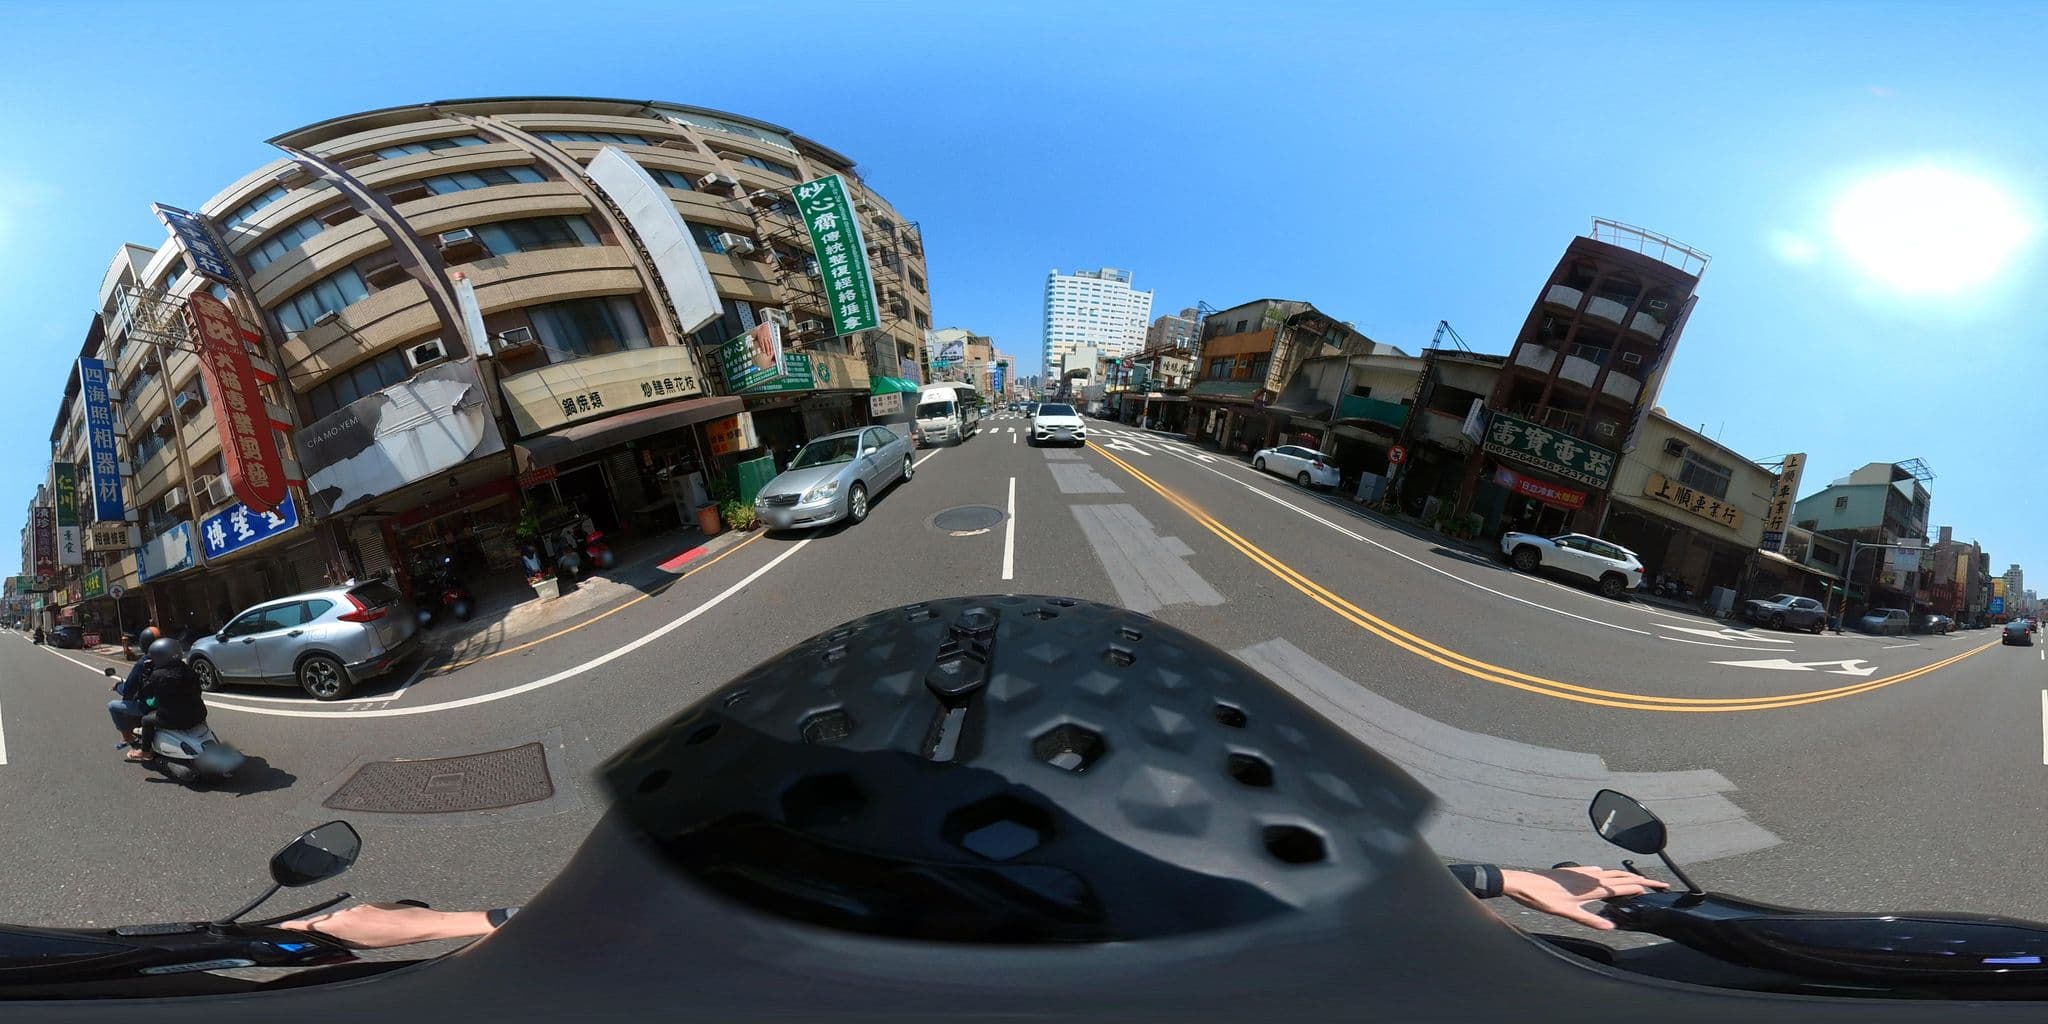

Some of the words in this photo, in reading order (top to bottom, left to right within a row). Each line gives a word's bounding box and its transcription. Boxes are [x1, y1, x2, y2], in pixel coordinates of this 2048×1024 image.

[820, 231, 863, 330] 傳統整復經絡推拿
[84, 367, 118, 503] 四海照相器材
[57, 474, 74, 511] 仁川
[1655, 479, 1736, 524] 上順車業行
[1769, 456, 1798, 530] 上順車業行
[64, 529, 77, 554] 素食
